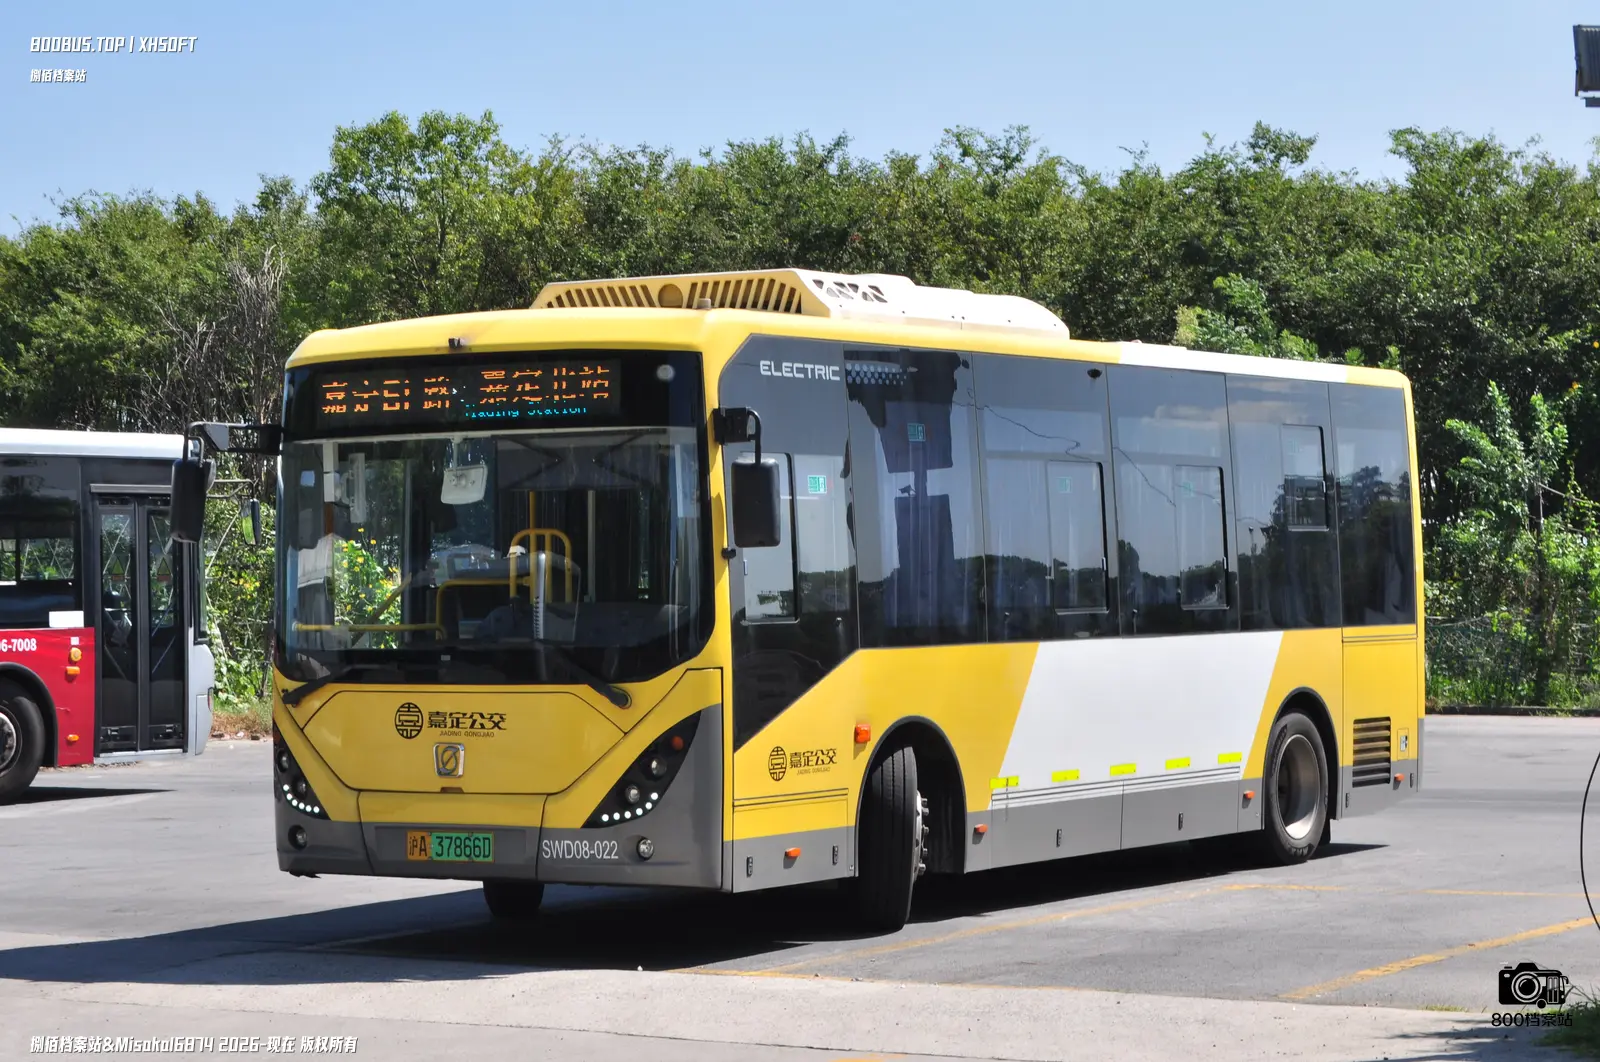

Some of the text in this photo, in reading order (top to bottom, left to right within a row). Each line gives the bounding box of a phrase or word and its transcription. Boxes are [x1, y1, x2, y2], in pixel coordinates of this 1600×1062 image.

[760, 360, 840, 381] ELECTRIC
[0, 638, 37, 652] 6-7008
[427, 711, 507, 730] 嘉定公交
[789, 748, 837, 768] 嘉定公交
[542, 840, 619, 859] SWD08-022
